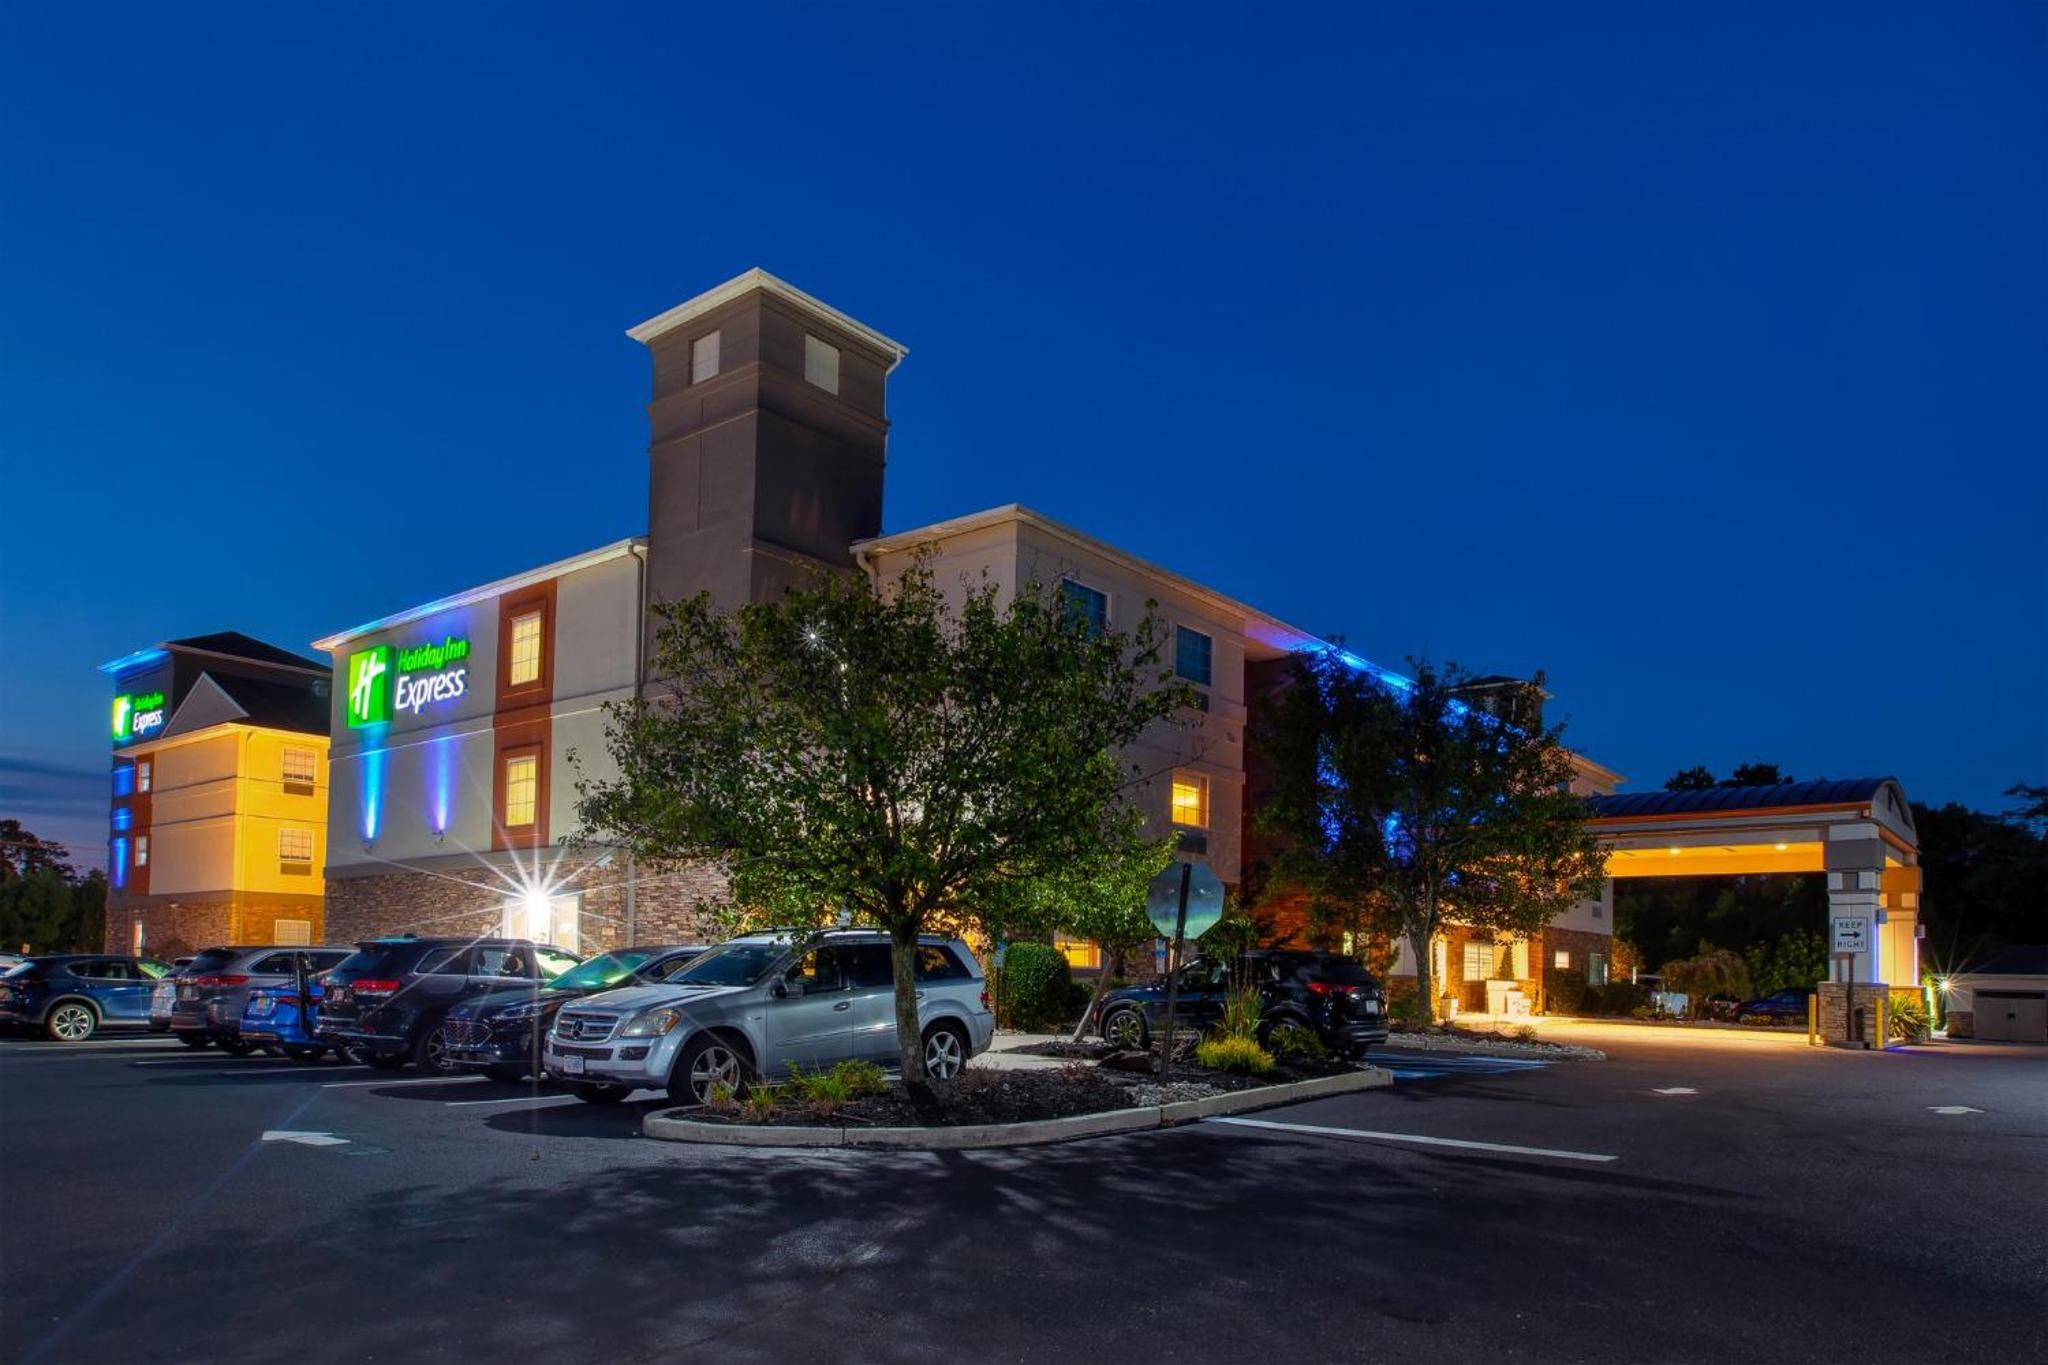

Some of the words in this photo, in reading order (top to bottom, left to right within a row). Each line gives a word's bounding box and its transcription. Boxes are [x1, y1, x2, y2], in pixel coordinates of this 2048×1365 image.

[399, 643, 444, 672] Holiday
[445, 636, 467, 661] Inn
[395, 669, 466, 714] Express
[1839, 920, 1862, 929] KEEP
